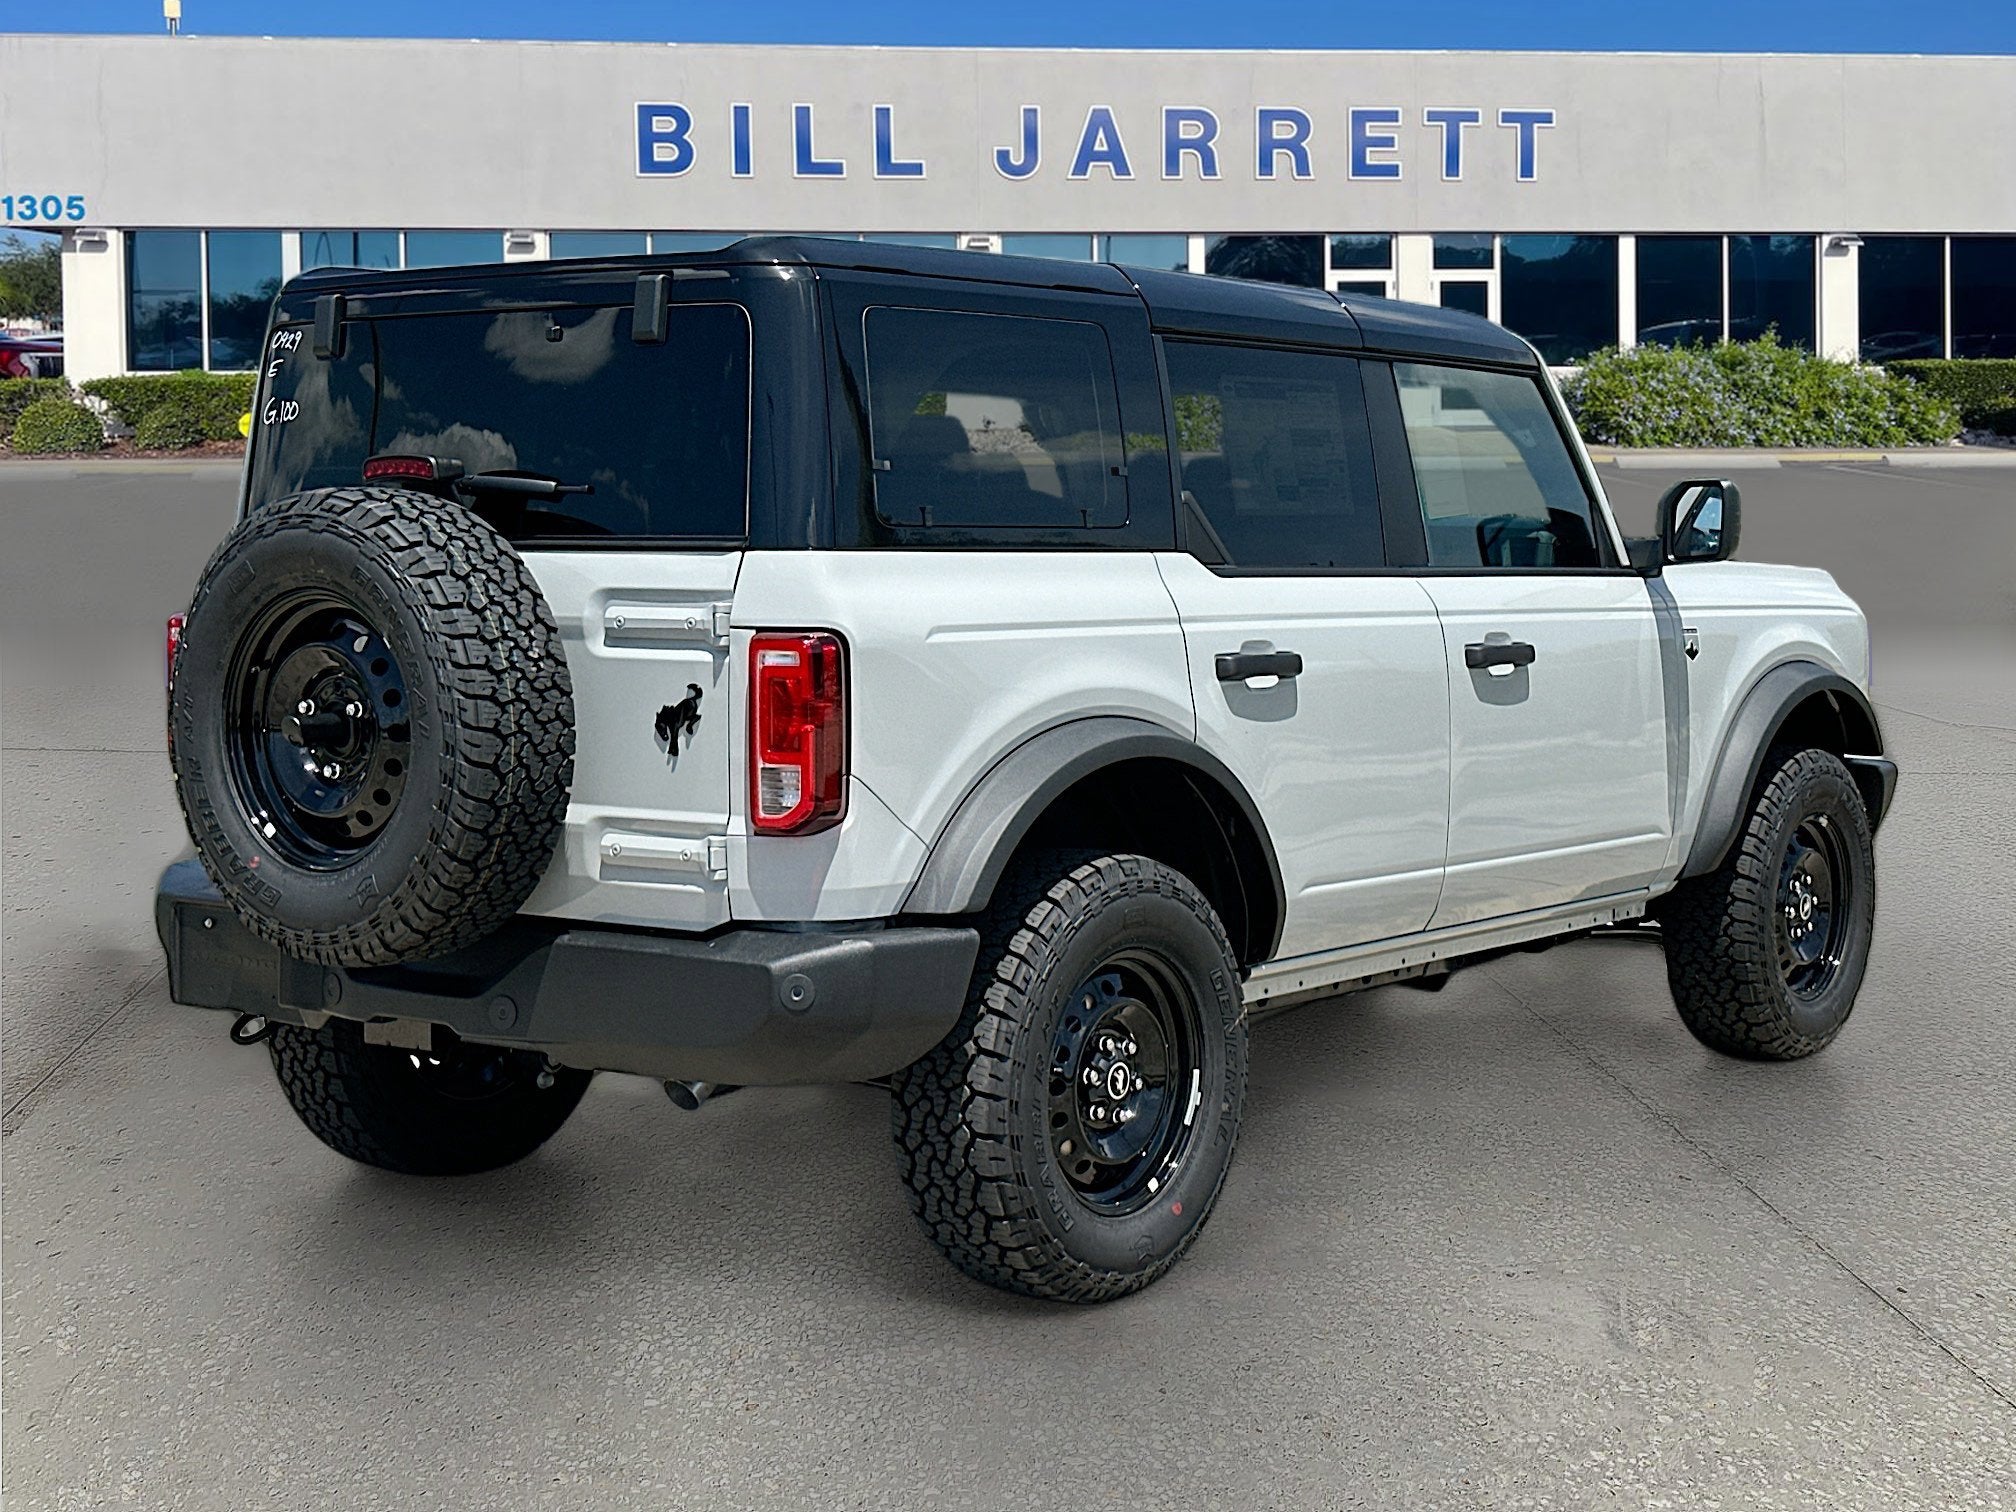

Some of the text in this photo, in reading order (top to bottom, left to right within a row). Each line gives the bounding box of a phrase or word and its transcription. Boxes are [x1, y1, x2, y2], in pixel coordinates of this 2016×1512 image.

[634, 101, 1556, 181] BILL JARRETT
[1, 195, 86, 221] 1305
[268, 359, 284, 377] E
[351, 564, 430, 738] GENERAL
[188, 756, 283, 908] GRABBER
[1210, 969, 1237, 1146] GENERAL
